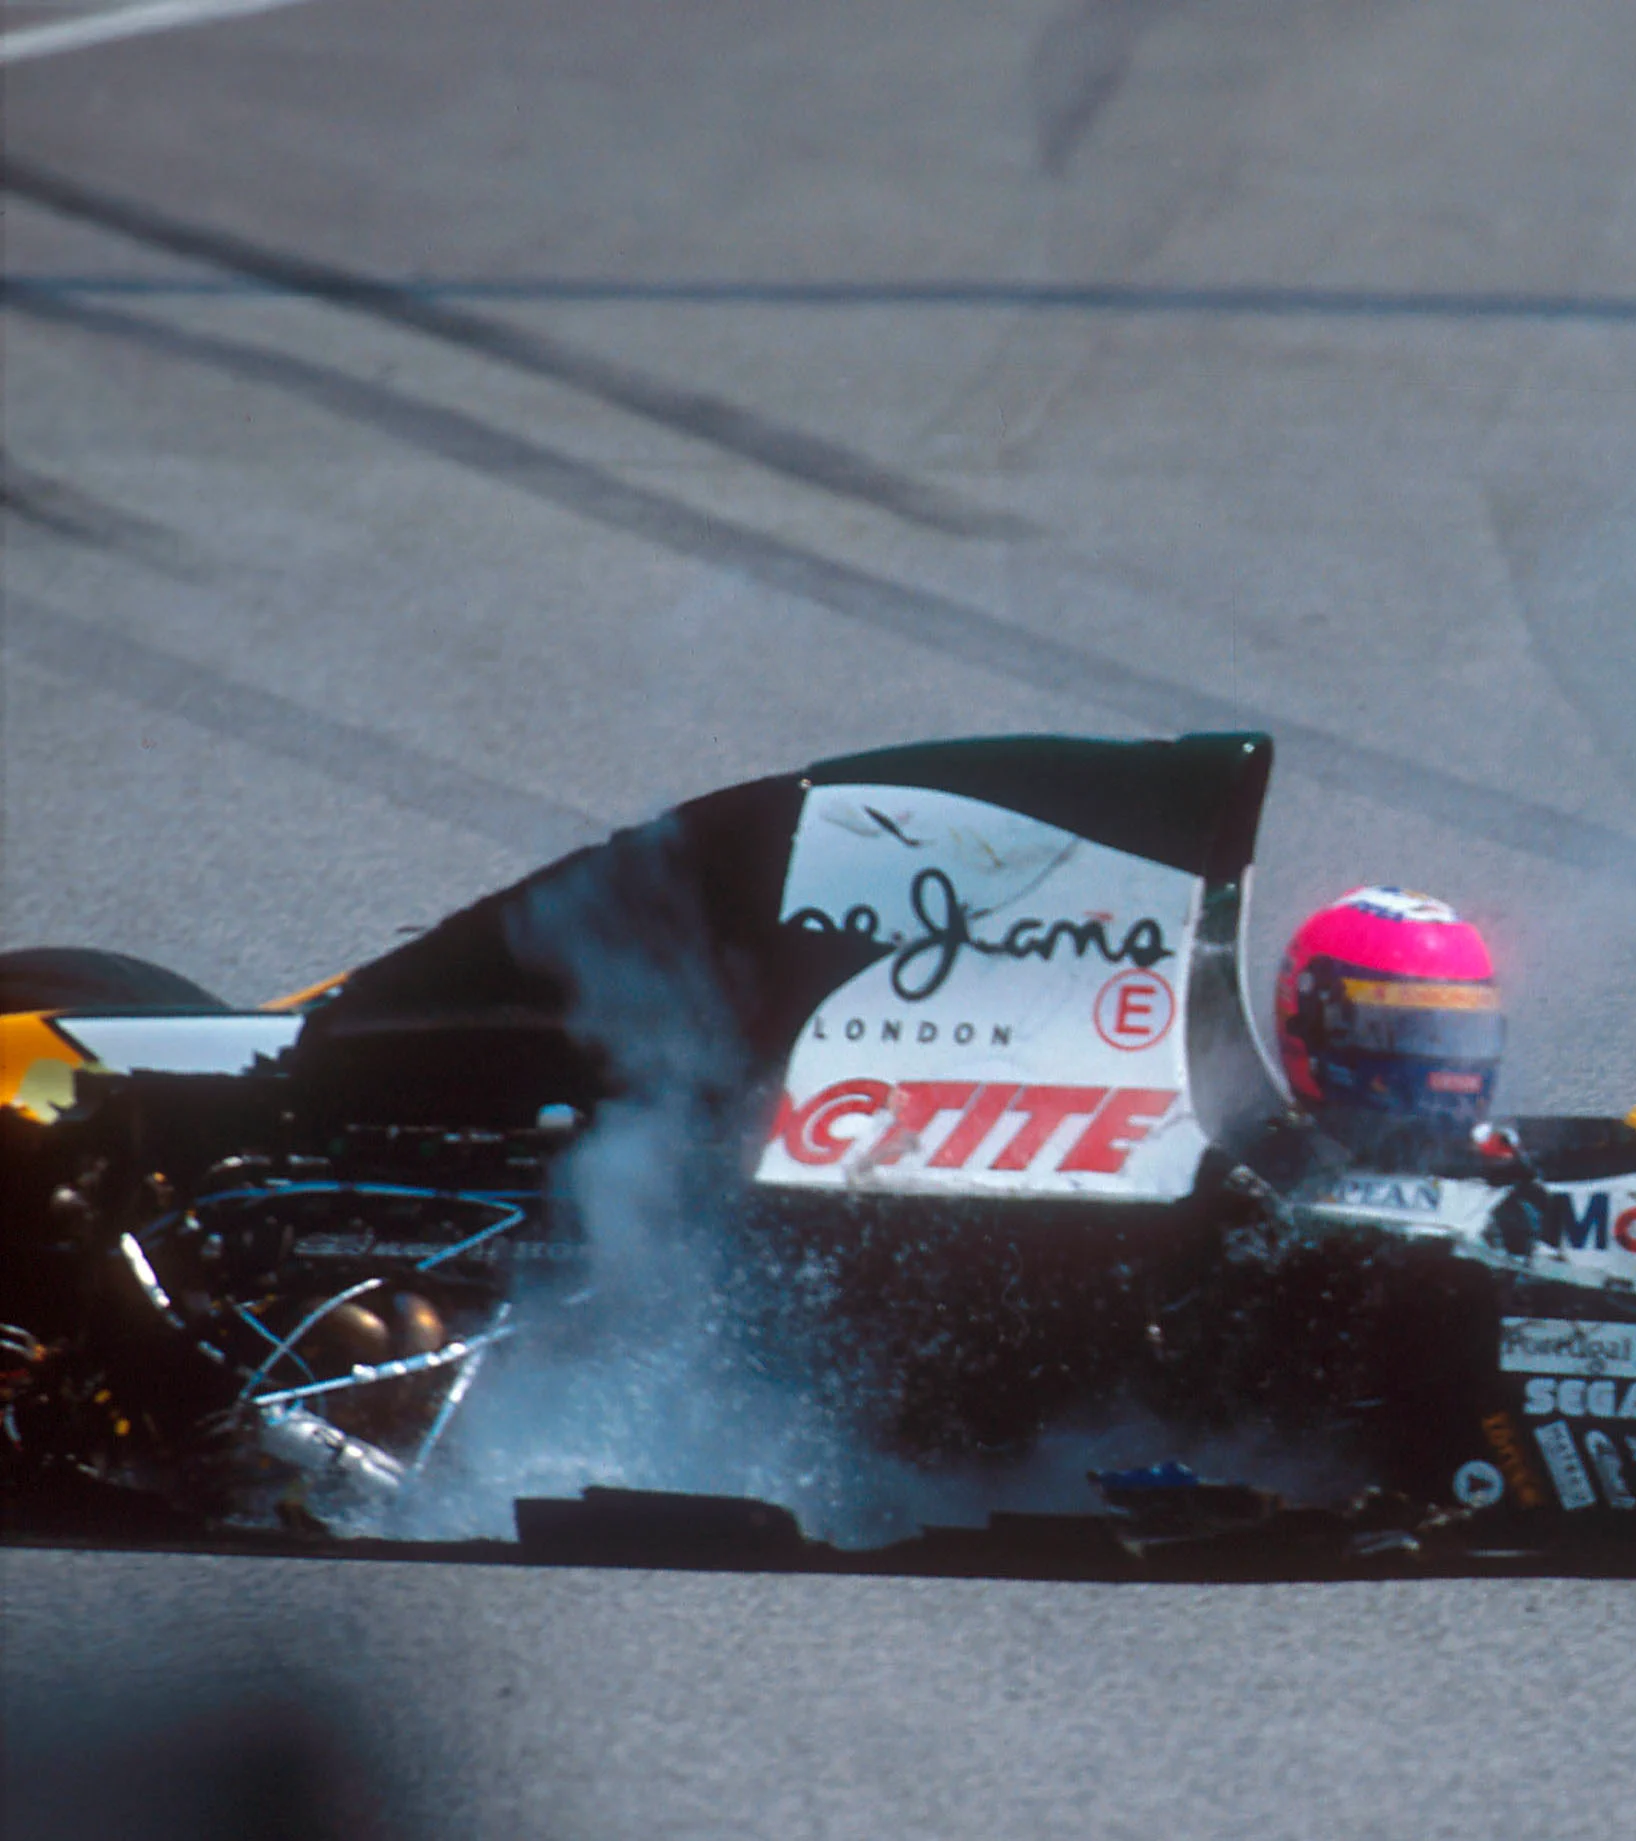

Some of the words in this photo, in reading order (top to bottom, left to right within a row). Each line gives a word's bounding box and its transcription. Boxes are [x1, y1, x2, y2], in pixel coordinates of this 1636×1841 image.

[813, 1014, 1012, 1046] LONDON
[1114, 984, 1156, 1035] E
[767, 1078, 1182, 1174] CTITE
